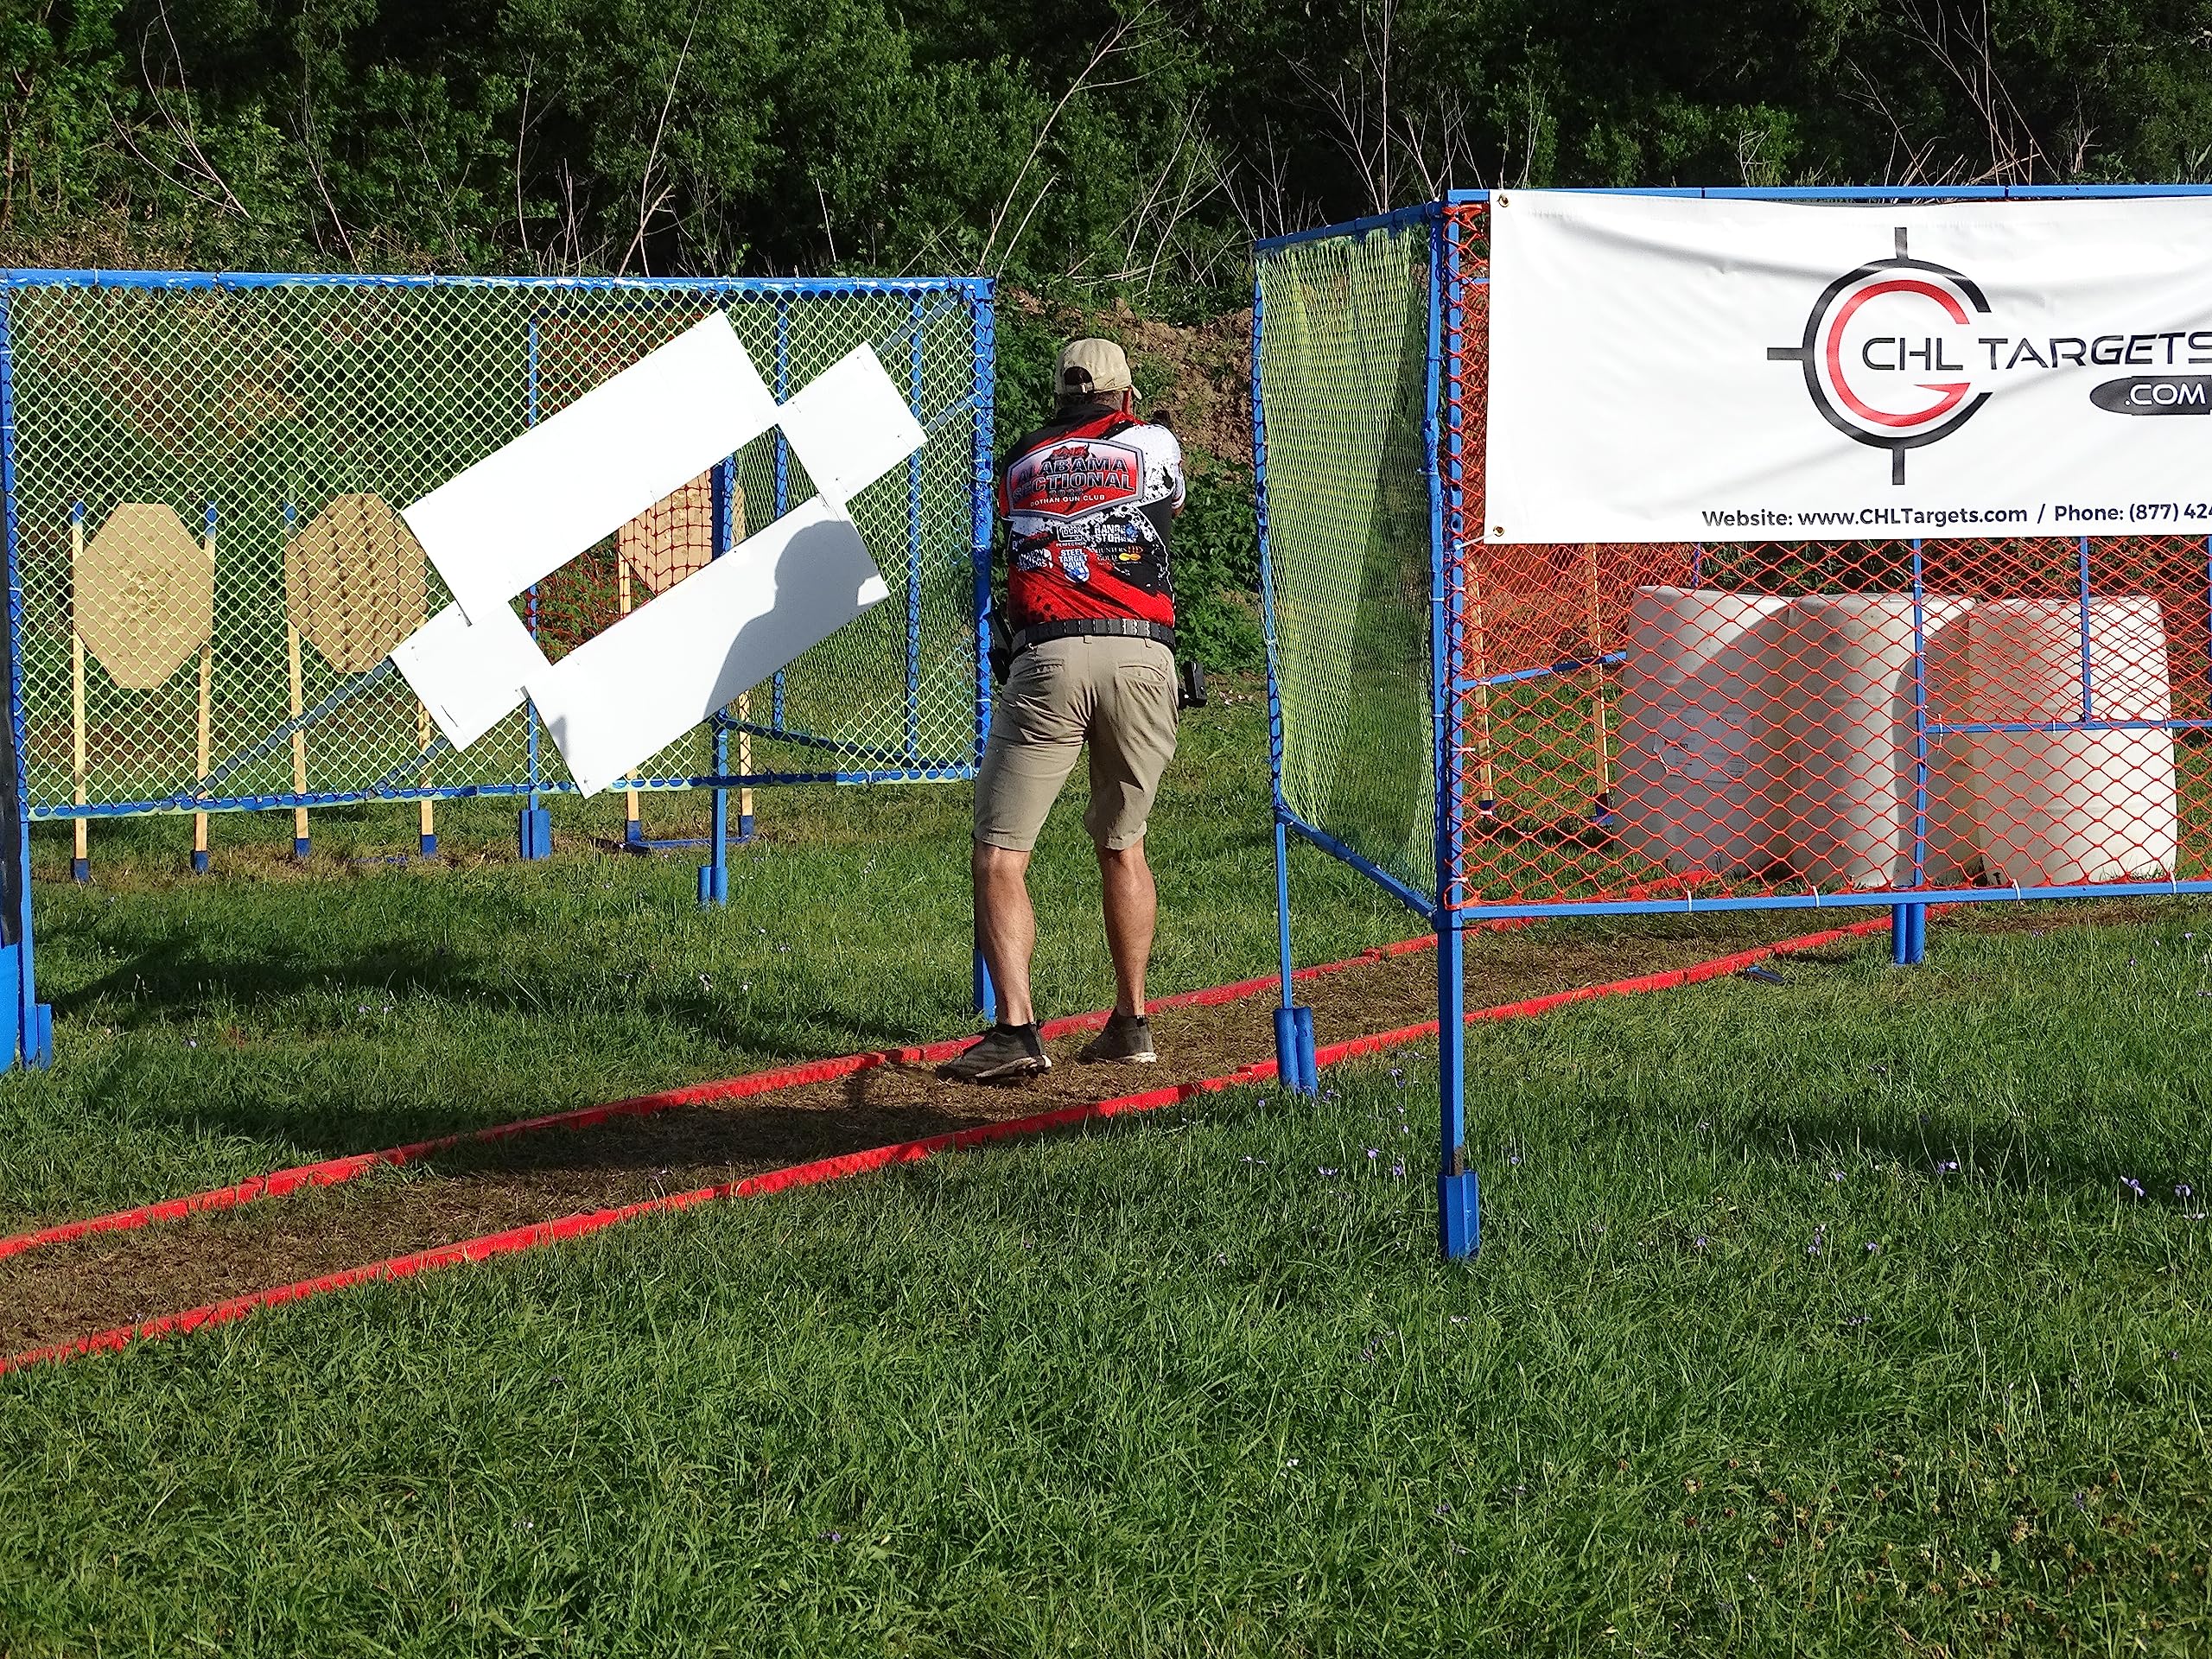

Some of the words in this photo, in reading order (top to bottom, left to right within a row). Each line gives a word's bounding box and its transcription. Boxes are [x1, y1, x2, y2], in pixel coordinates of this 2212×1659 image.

[1862, 337, 1963, 371] CHL
[1979, 332, 2212, 371] TARGETS
[2125, 382, 2207, 406] .COM
[1018, 456, 1129, 485] ALABAMA
[1012, 472, 1135, 499] SECTIONAL
[1030, 496, 1062, 507] DOTHAN
[1701, 508, 1793, 526] Website:
[1797, 507, 2028, 528] www.CHLTargets.com
[2054, 505, 2124, 522] Phone:
[2129, 503, 2179, 523] (877)
[1058, 554, 1089, 563] TARGET
[1062, 561, 1085, 570] PAINT
